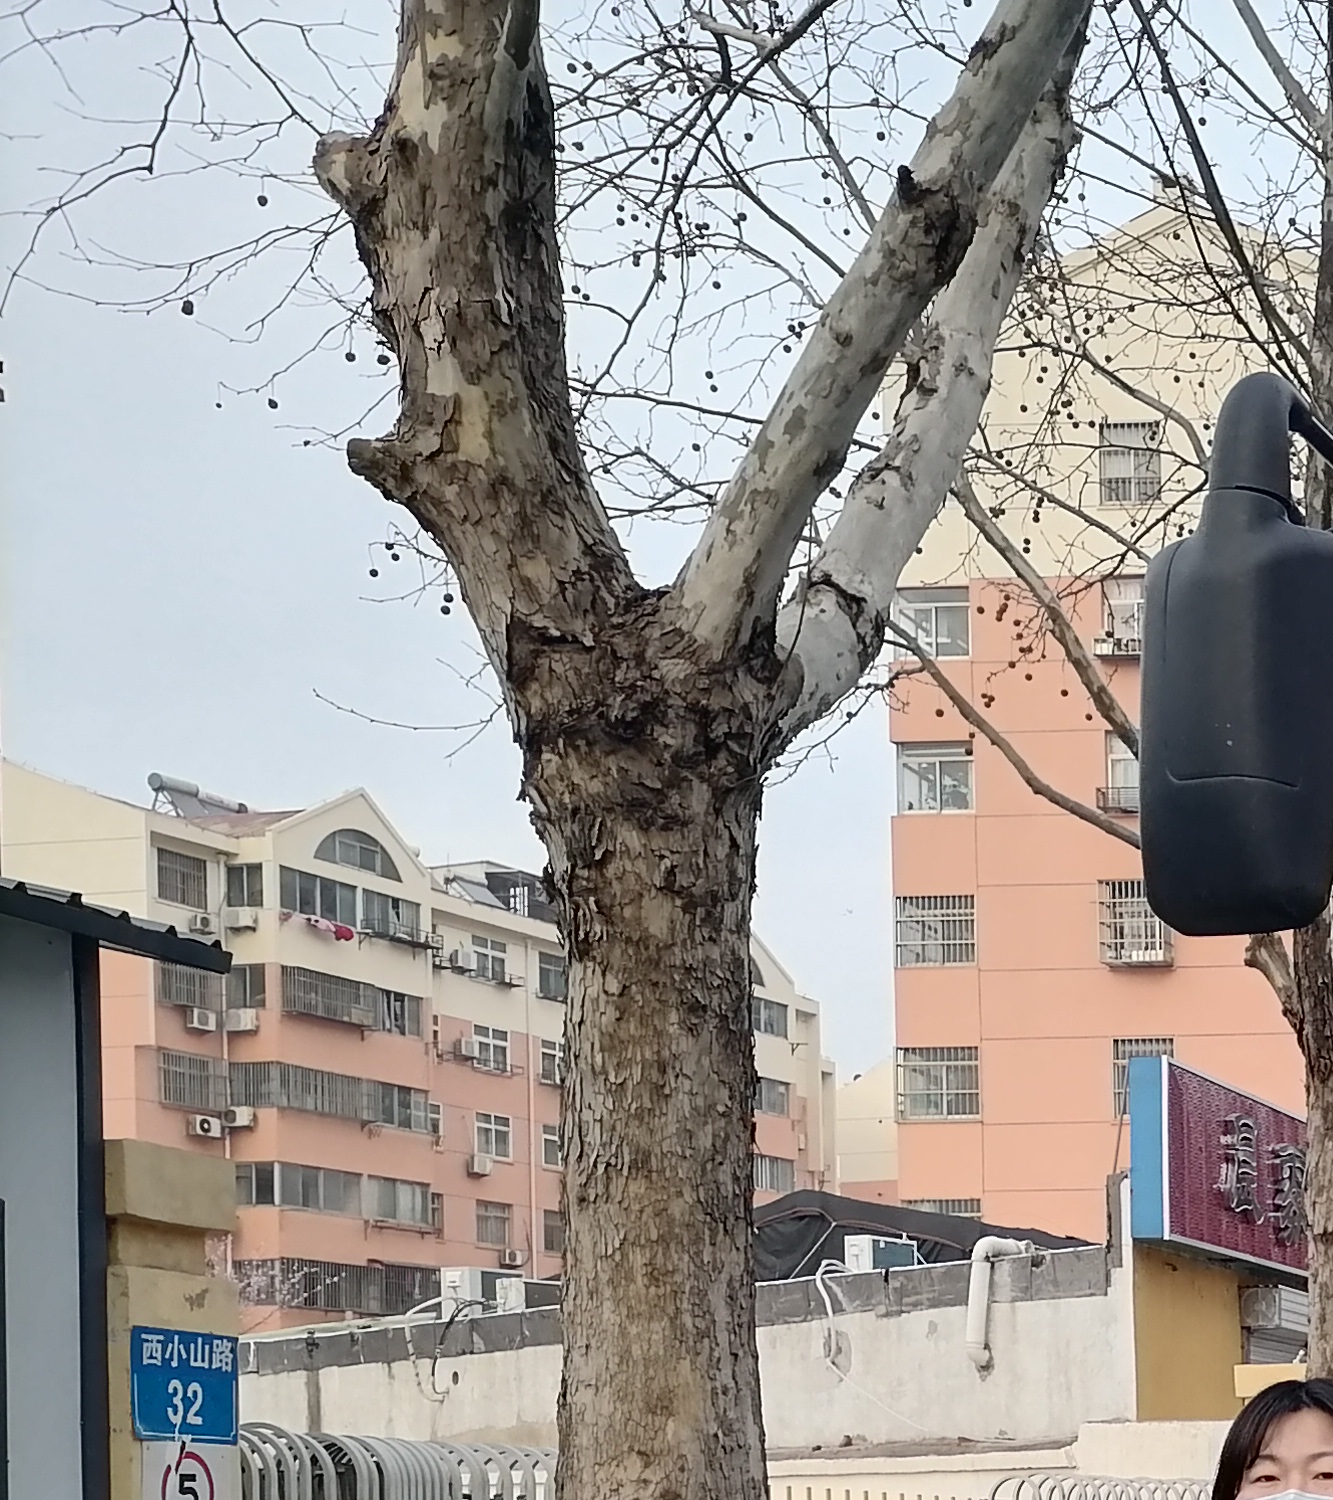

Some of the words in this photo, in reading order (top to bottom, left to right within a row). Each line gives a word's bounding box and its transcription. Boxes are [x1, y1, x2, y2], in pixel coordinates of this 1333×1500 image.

[140, 1333, 234, 1372] 西小山路
[166, 1378, 204, 1426] 32
